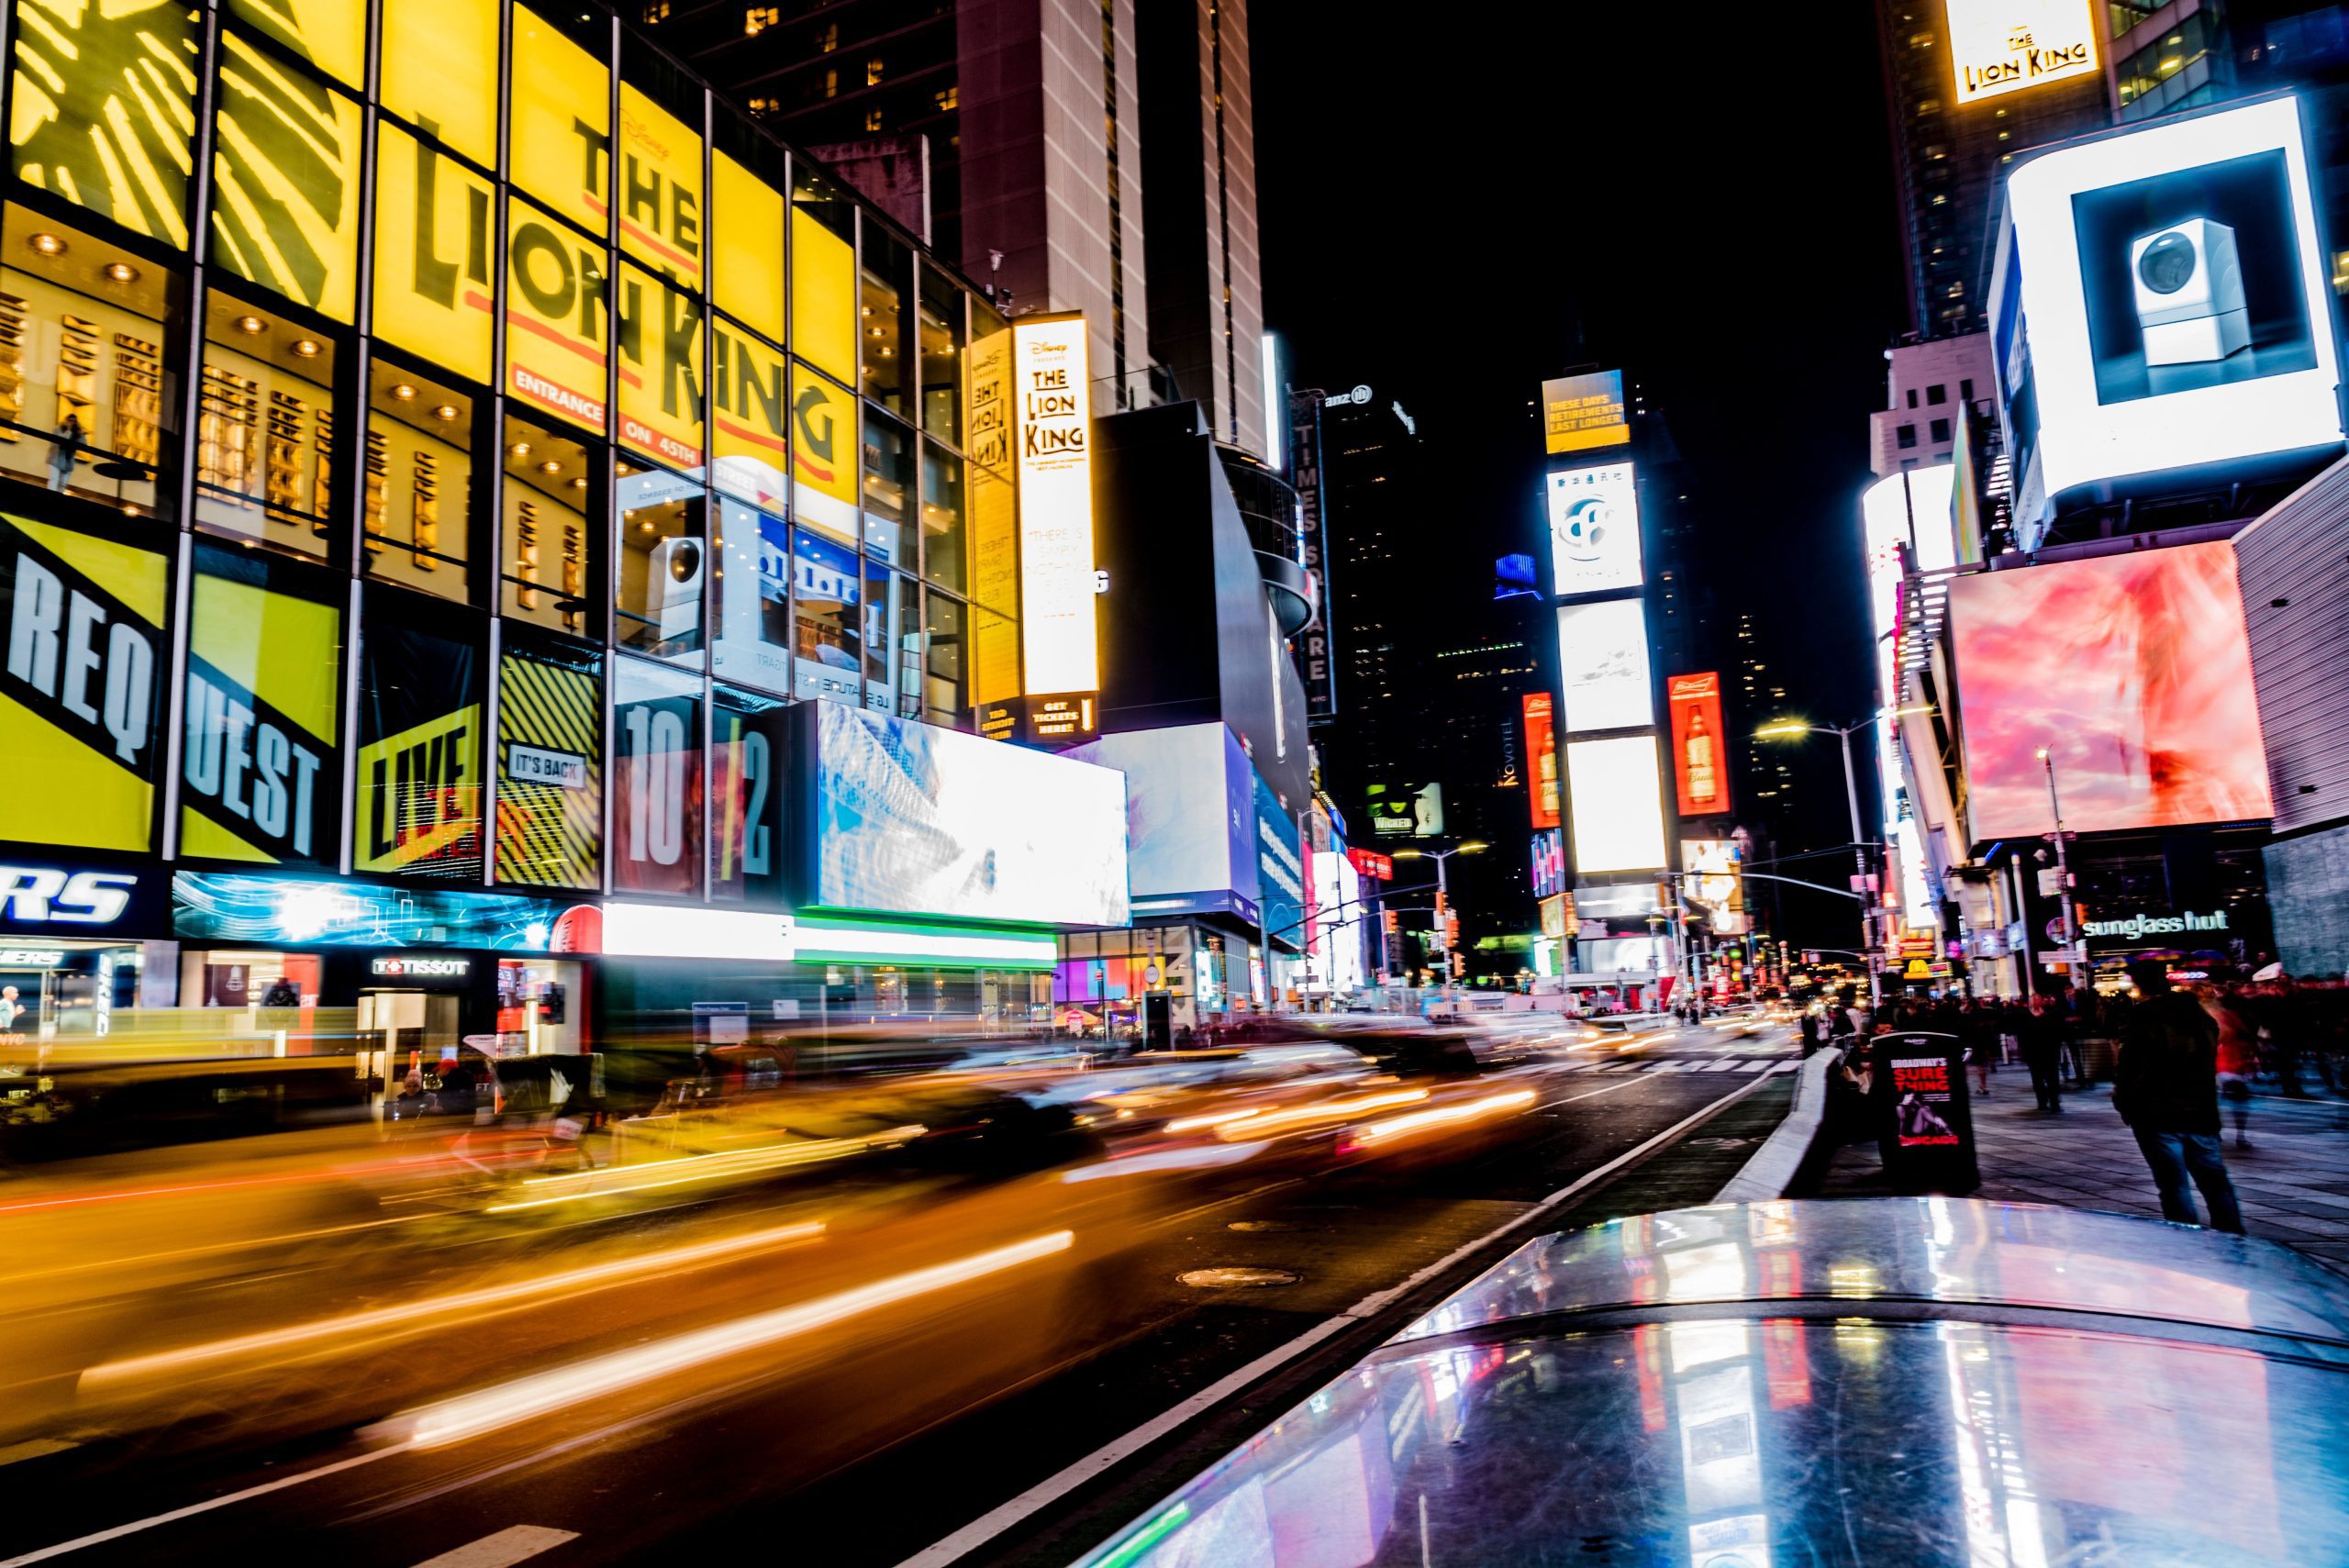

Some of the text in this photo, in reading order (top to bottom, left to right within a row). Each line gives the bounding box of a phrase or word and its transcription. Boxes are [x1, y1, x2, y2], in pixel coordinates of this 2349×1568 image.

[2007, 34, 2032, 50] THE
[1964, 44, 2086, 93] LION KING
[573, 117, 698, 257] THE
[413, 112, 833, 463] LION KING
[1027, 340, 1068, 355] Disney
[1032, 369, 1066, 387] THE
[1028, 393, 1074, 420] LION
[1549, 394, 1610, 412] THESE DAYS
[516, 369, 696, 465] ENTRANCE ON 45TH
[1550, 420, 1577, 433] LAST
[1024, 424, 1084, 458] KING
[1294, 425, 1327, 681] TIMES SQARE
[7, 551, 321, 857] REQUEST
[1032, 711, 1079, 723] TICKETS
[1044, 702, 1068, 711] GET
[1500, 717, 1520, 787] NOVOTEL
[516, 753, 576, 780] IT'S BACK
[369, 725, 468, 862] LIVE
[2082, 910, 2230, 940] sunglass hut
[400, 959, 471, 975] TISSOT
[1890, 1057, 1947, 1069] BROADWAY'S
[1893, 1066, 1949, 1081] SURE
[1895, 1080, 1951, 1092] THING
